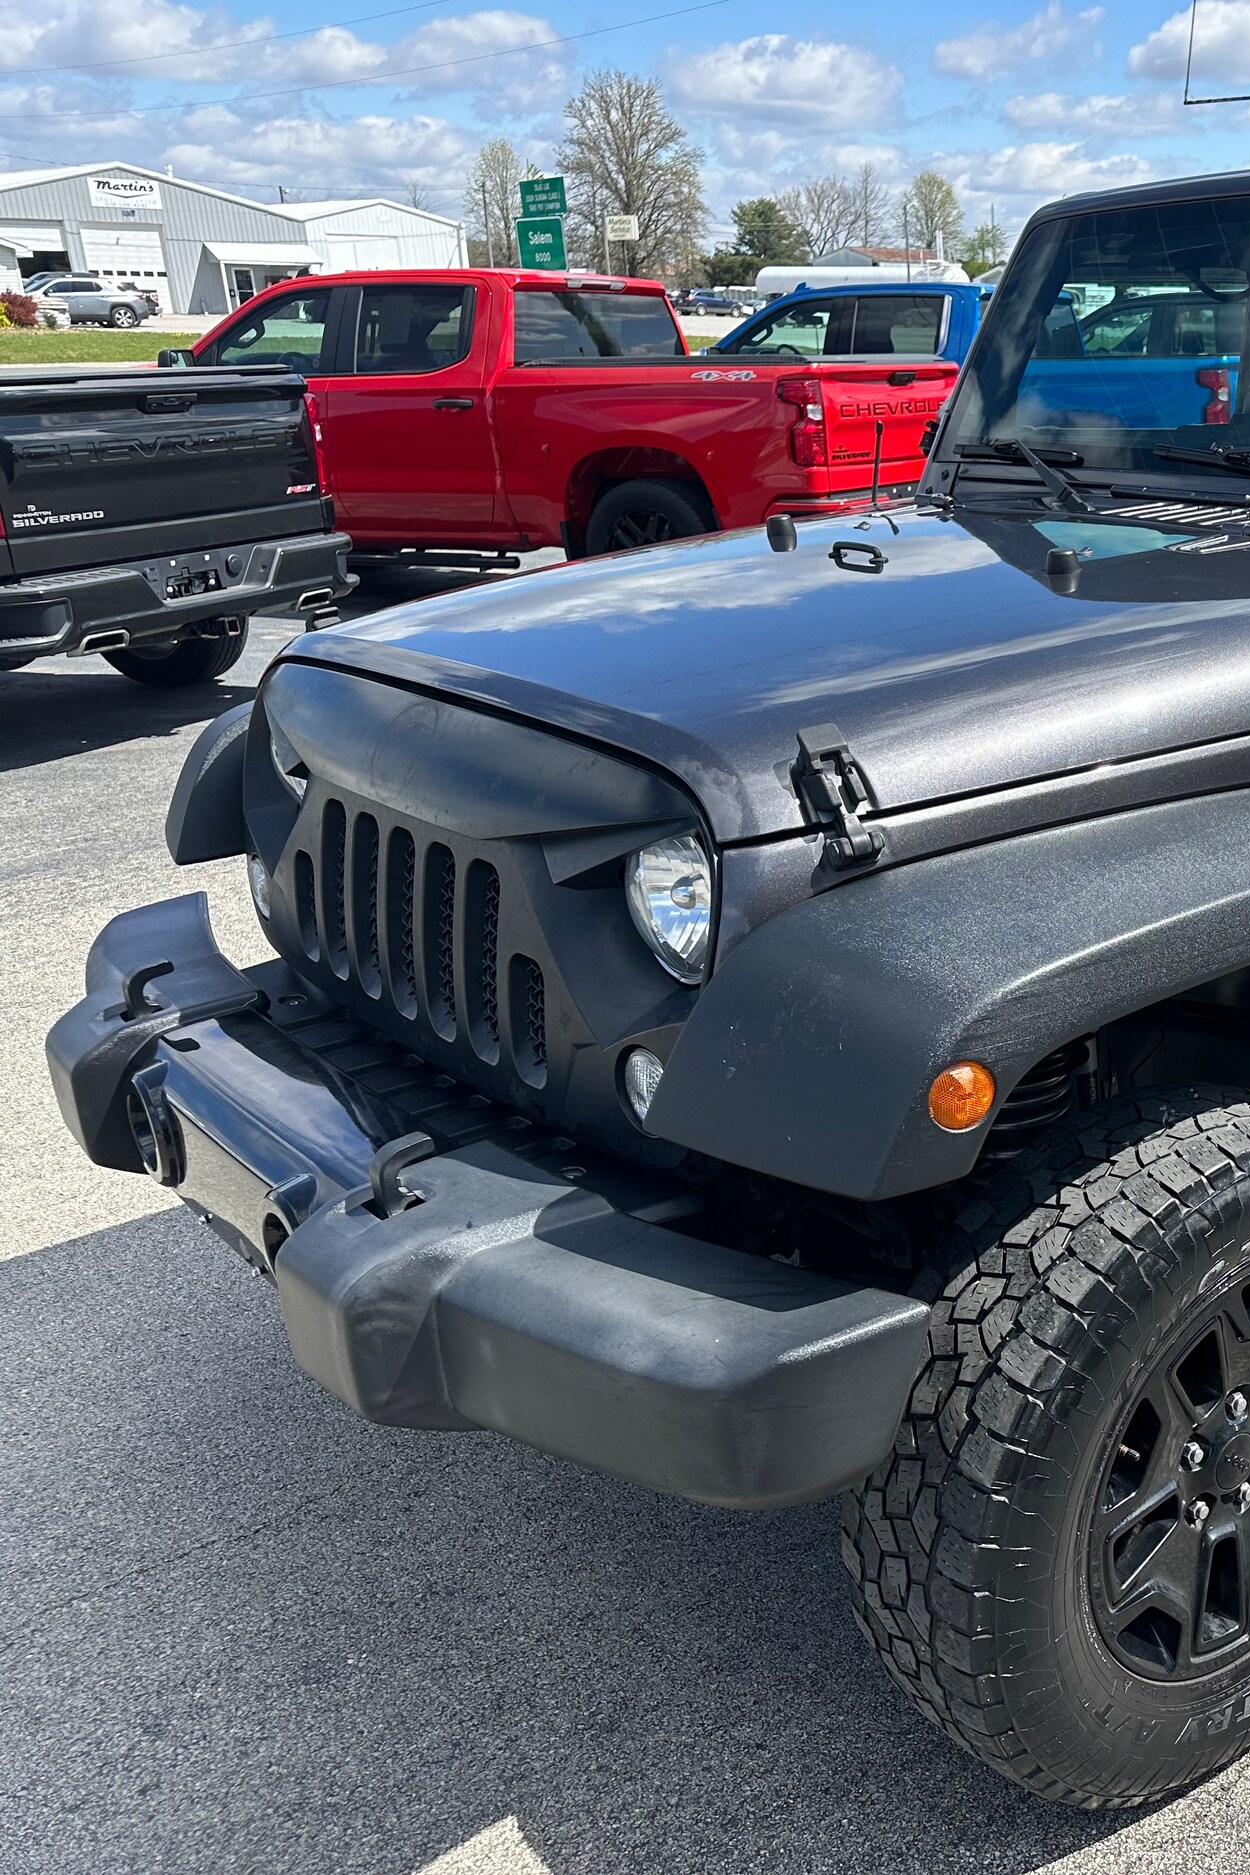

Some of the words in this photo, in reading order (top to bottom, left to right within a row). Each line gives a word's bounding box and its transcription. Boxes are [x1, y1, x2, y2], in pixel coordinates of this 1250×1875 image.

[94, 180, 154, 192] Martin's
[528, 231, 553, 245] Salem
[535, 252, 551, 262] 8000
[840, 400, 943, 418] CHEVROL
[22, 423, 298, 468] CHEVROLET
[286, 483, 316, 494] RST
[12, 510, 104, 528] SILVERADO
